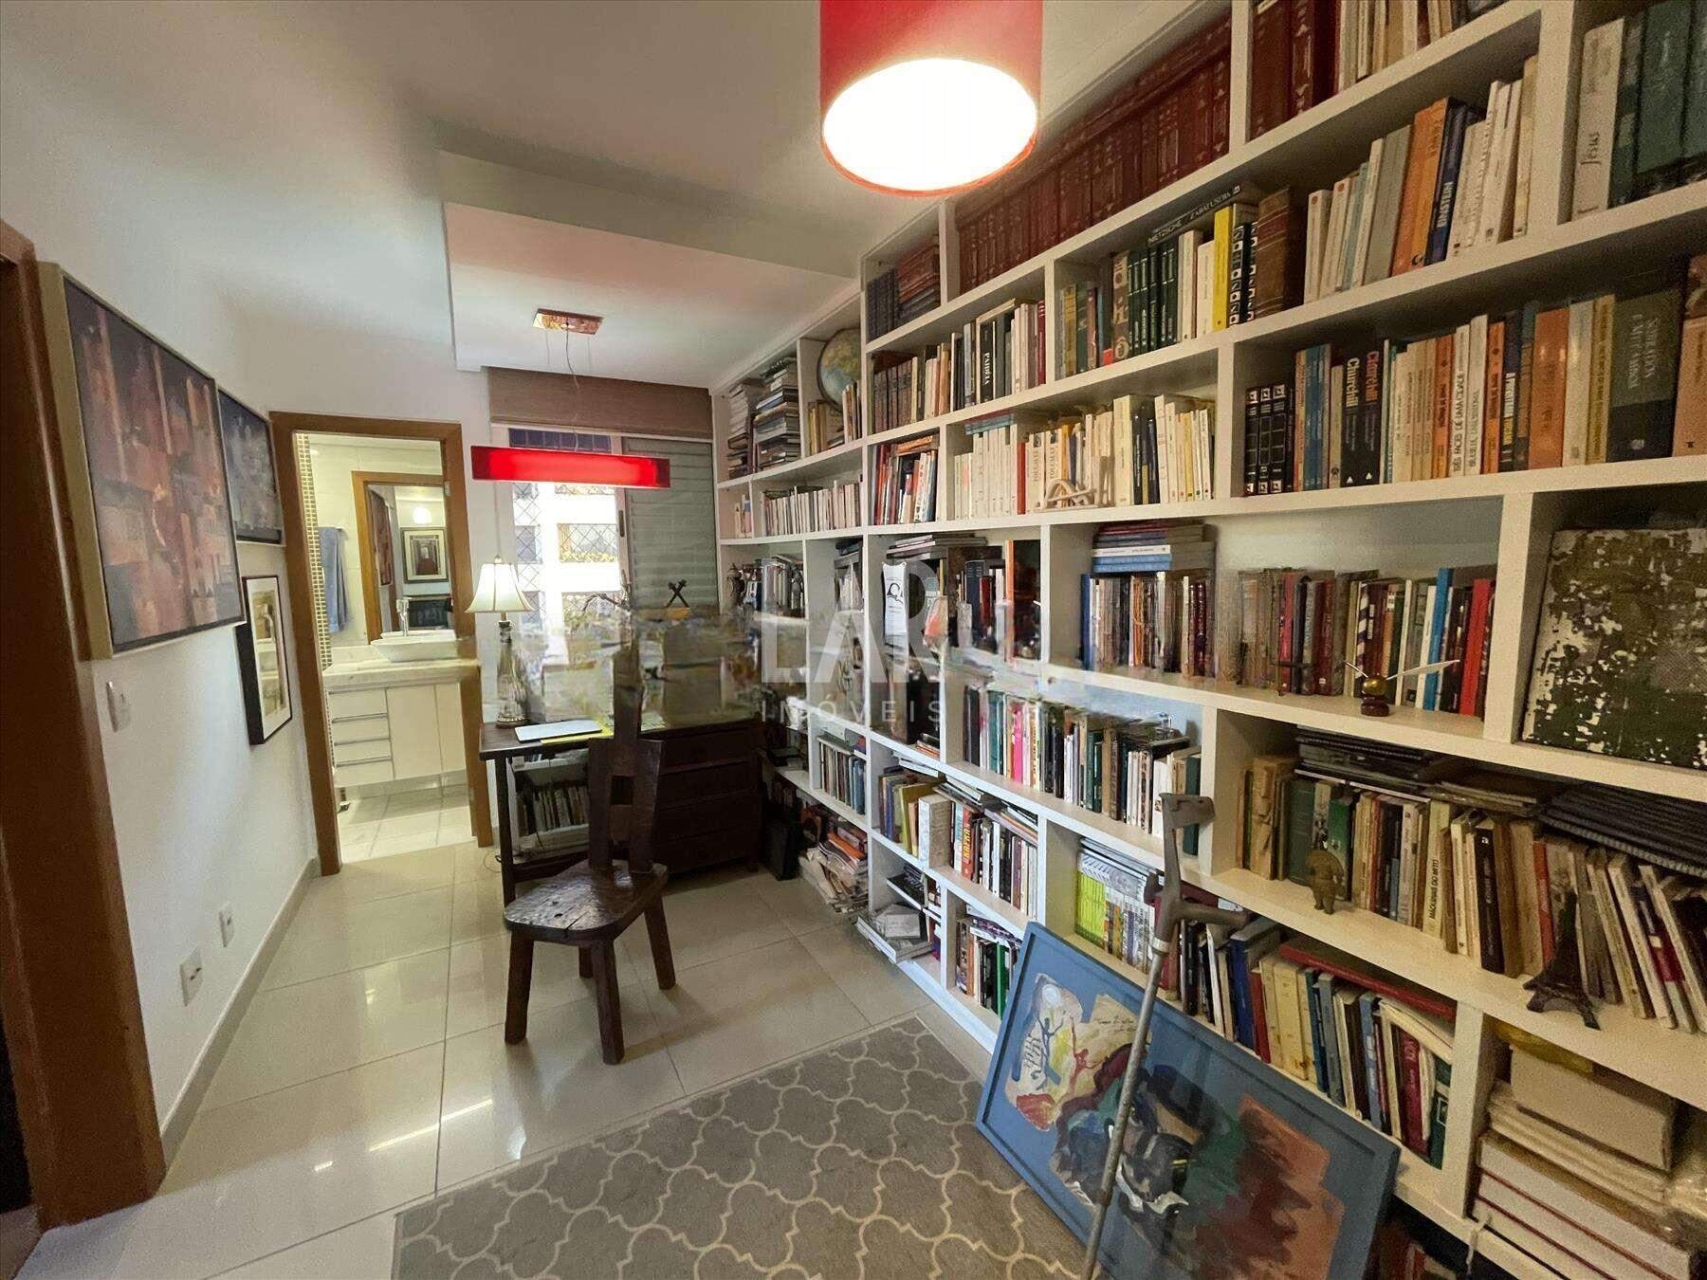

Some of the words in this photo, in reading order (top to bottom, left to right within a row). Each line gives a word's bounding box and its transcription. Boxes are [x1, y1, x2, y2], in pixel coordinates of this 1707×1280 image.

[1579, 131, 1602, 166] Jesus
[1345, 357, 1360, 407] Churchill
[1366, 351, 1380, 402] Churchill
